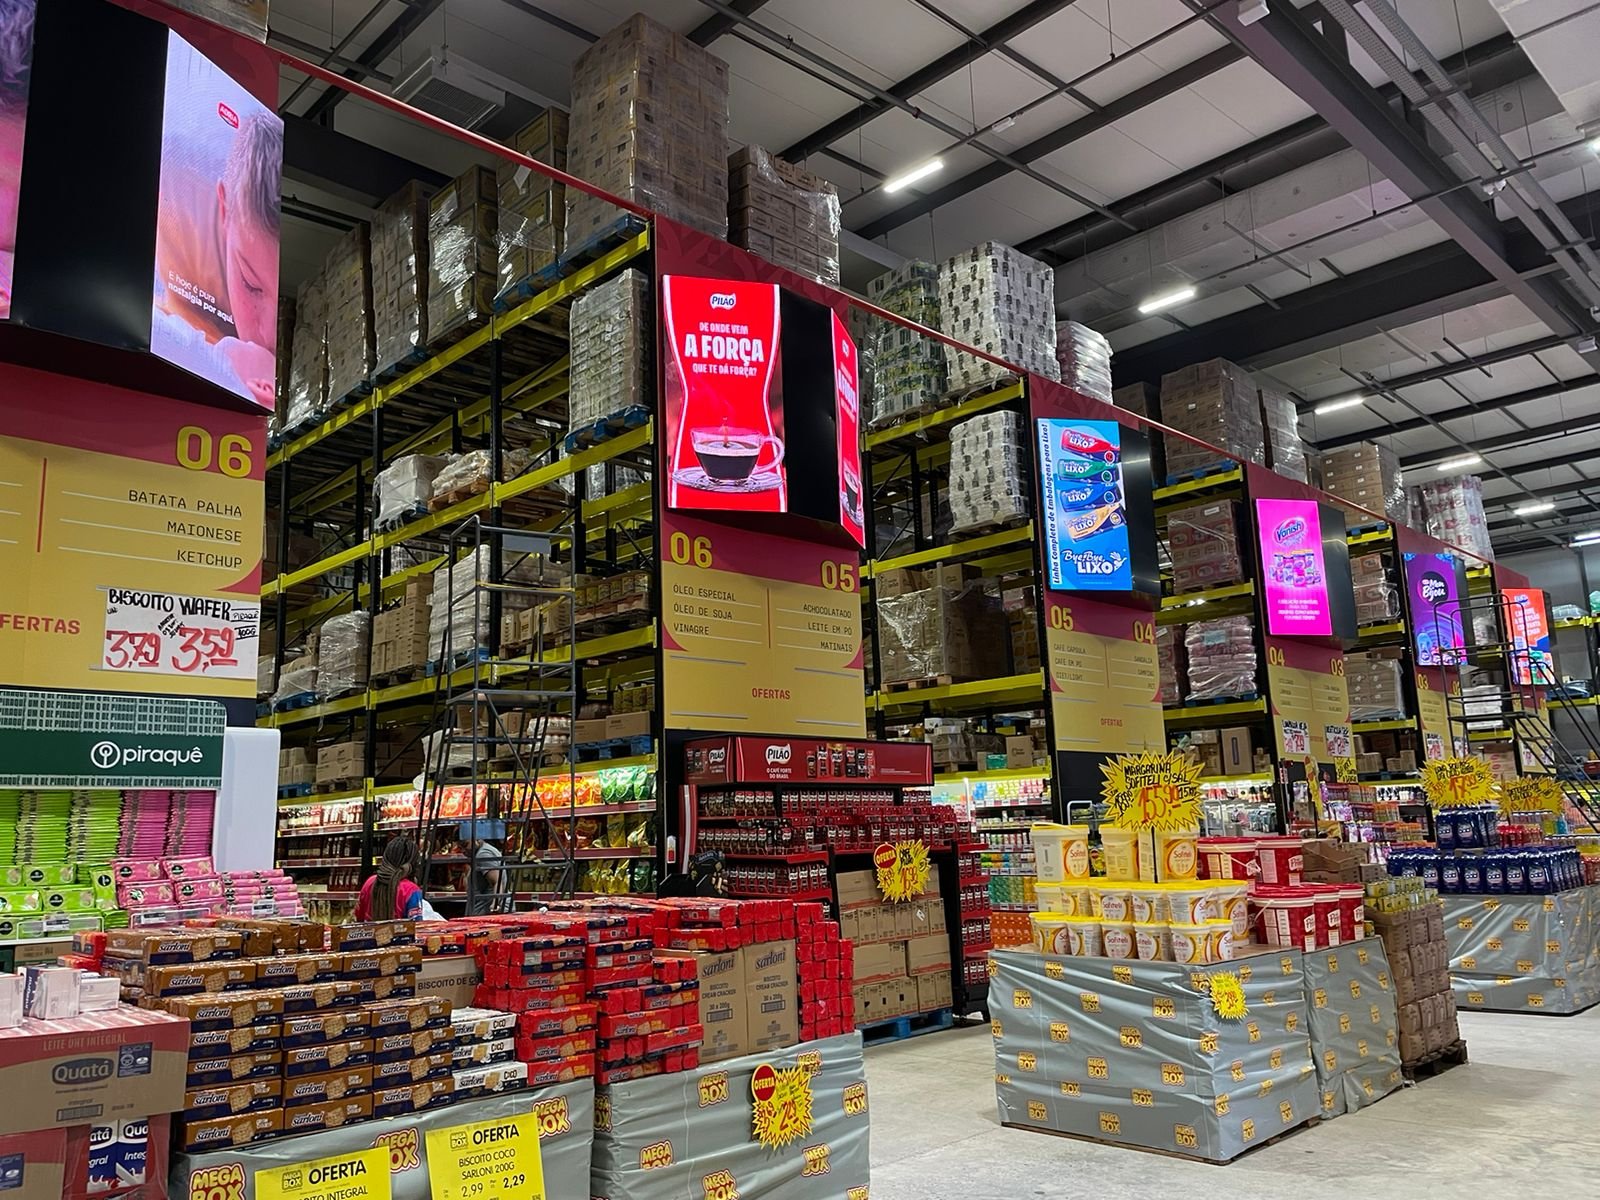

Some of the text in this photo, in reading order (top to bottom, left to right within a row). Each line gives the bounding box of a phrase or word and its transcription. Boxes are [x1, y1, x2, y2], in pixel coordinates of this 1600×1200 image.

[175, 274, 192, 290] hoje
[199, 290, 215, 304] pura
[168, 282, 202, 306] nostalgia
[203, 302, 216, 314] por
[712, 295, 734, 307] PILÃO
[699, 322, 748, 334] DE ONDE VEM
[685, 334, 764, 367] A FORÇA
[692, 363, 708, 374] QUE
[709, 364, 717, 374] TE
[1070, 437, 1088, 449] LIXO
[176, 425, 253, 477] 06
[1065, 465, 1085, 473] LIXO
[129, 490, 242, 517] BATATA PALHA
[1068, 493, 1087, 503] LIXO
[1048, 511, 1055, 521] de
[167, 521, 242, 543] MAIONESE
[1075, 520, 1094, 532] LIXO
[1276, 522, 1302, 541] Vanish
[670, 532, 713, 568] 06
[177, 550, 242, 568] KETCHUP
[1077, 562, 1113, 574] LIXO
[821, 561, 855, 592] 05
[1430, 579, 1444, 588] Mon
[698, 588, 736, 601] ESPECIAL
[179, 598, 231, 621] WAFER
[673, 603, 732, 619] ÓLEO DE SOJA
[803, 604, 851, 618] ACHOCOLATADO
[0, 613, 80, 634] FERTAS
[1051, 605, 1074, 631] 05
[674, 623, 709, 635] VINAGRE
[808, 622, 829, 632] LEITE
[832, 626, 842, 634] EM
[1134, 621, 1154, 645] 04
[172, 627, 235, 672] 3,59
[820, 641, 853, 652] MATINAIS
[1270, 647, 1285, 667] 04
[1331, 659, 1344, 676] 03
[1417, 673, 1429, 690] 03
[752, 688, 791, 700] OFERTAS
[1101, 718, 1123, 727] OFERTAS
[123, 745, 203, 766] piraquê
[768, 748, 790, 760] PILÃO
[1124, 762, 1171, 776] MARGARINA
[876, 850, 896, 864] OFERTA
[702, 955, 735, 977] sarloni
[755, 948, 786, 970] sarloni
[417, 976, 467, 990] BISCOITO DE
[1014, 997, 1032, 1008] BOX
[1153, 1006, 1176, 1018] BOX
[43, 1040, 65, 1051] LEITE
[86, 1032, 126, 1046] INTEGRAL
[1121, 1035, 1142, 1048] BOX
[1201, 1041, 1218, 1053] BO
[54, 1060, 109, 1082] Quatá
[1089, 1067, 1108, 1078] BOX
[754, 1077, 775, 1090] OFERTA
[1163, 1072, 1184, 1085] BOX
[700, 1083, 728, 1105] BOX
[844, 1084, 865, 1098] MEGA
[845, 1095, 866, 1115] BOX
[90, 1128, 109, 1141] atá
[124, 1125, 148, 1137] Qua
[473, 1124, 519, 1145] OFERTA
[451, 1139, 468, 1148] BOX
[1176, 1134, 1197, 1148] BOX
[124, 1151, 147, 1160] Inte
[390, 1145, 419, 1168] OX
[459, 1148, 516, 1168] BISCOITO COCO
[641, 1145, 670, 1161] MEGA
[806, 1146, 829, 1160] MEGA
[89, 1155, 108, 1168] gral
[193, 1166, 242, 1190] MEGA
[308, 1160, 367, 1185] OFERTA
[462, 1162, 515, 1180] SARLONI 200G
[284, 1179, 301, 1189] BOX
[462, 1174, 525, 1198] 2,99 2,29
[704, 1173, 733, 1190] MEGA
[327, 1185, 368, 1200] INTEGRAL
